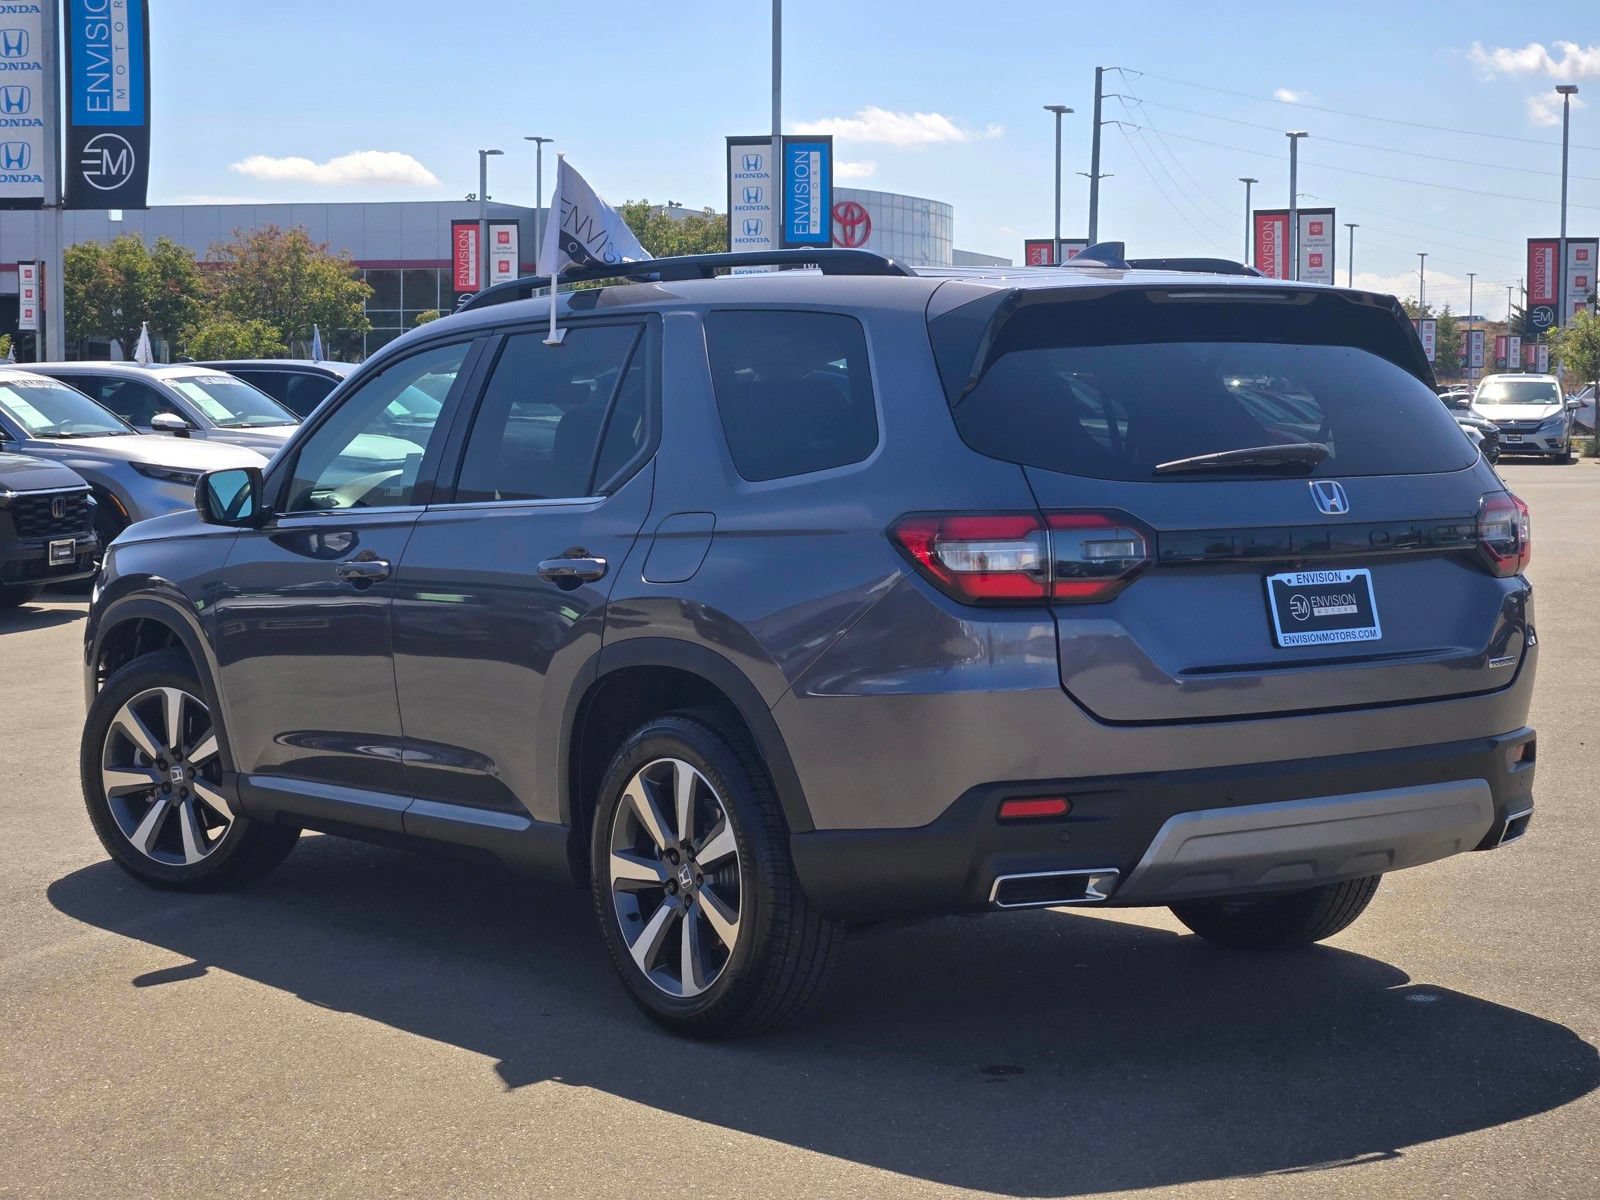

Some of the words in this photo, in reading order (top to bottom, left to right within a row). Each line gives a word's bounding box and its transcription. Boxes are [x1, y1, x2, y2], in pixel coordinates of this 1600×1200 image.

[0, 5, 41, 14] ONDA
[113, 0, 126, 99] MOTOR
[0, 62, 42, 71] ONDA
[0, 118, 43, 127] ONDA
[0, 174, 44, 183] ONDA
[794, 151, 809, 235] ENVISION
[1263, 220, 1274, 277] NVISION
[459, 230, 469, 286] ENVISION
[1534, 247, 1545, 299] ENVISION
[1296, 571, 1342, 584] ENVISION
[1310, 593, 1357, 608] ENVISION
[1283, 629, 1378, 645] ENVISIONMOTORS.COM
